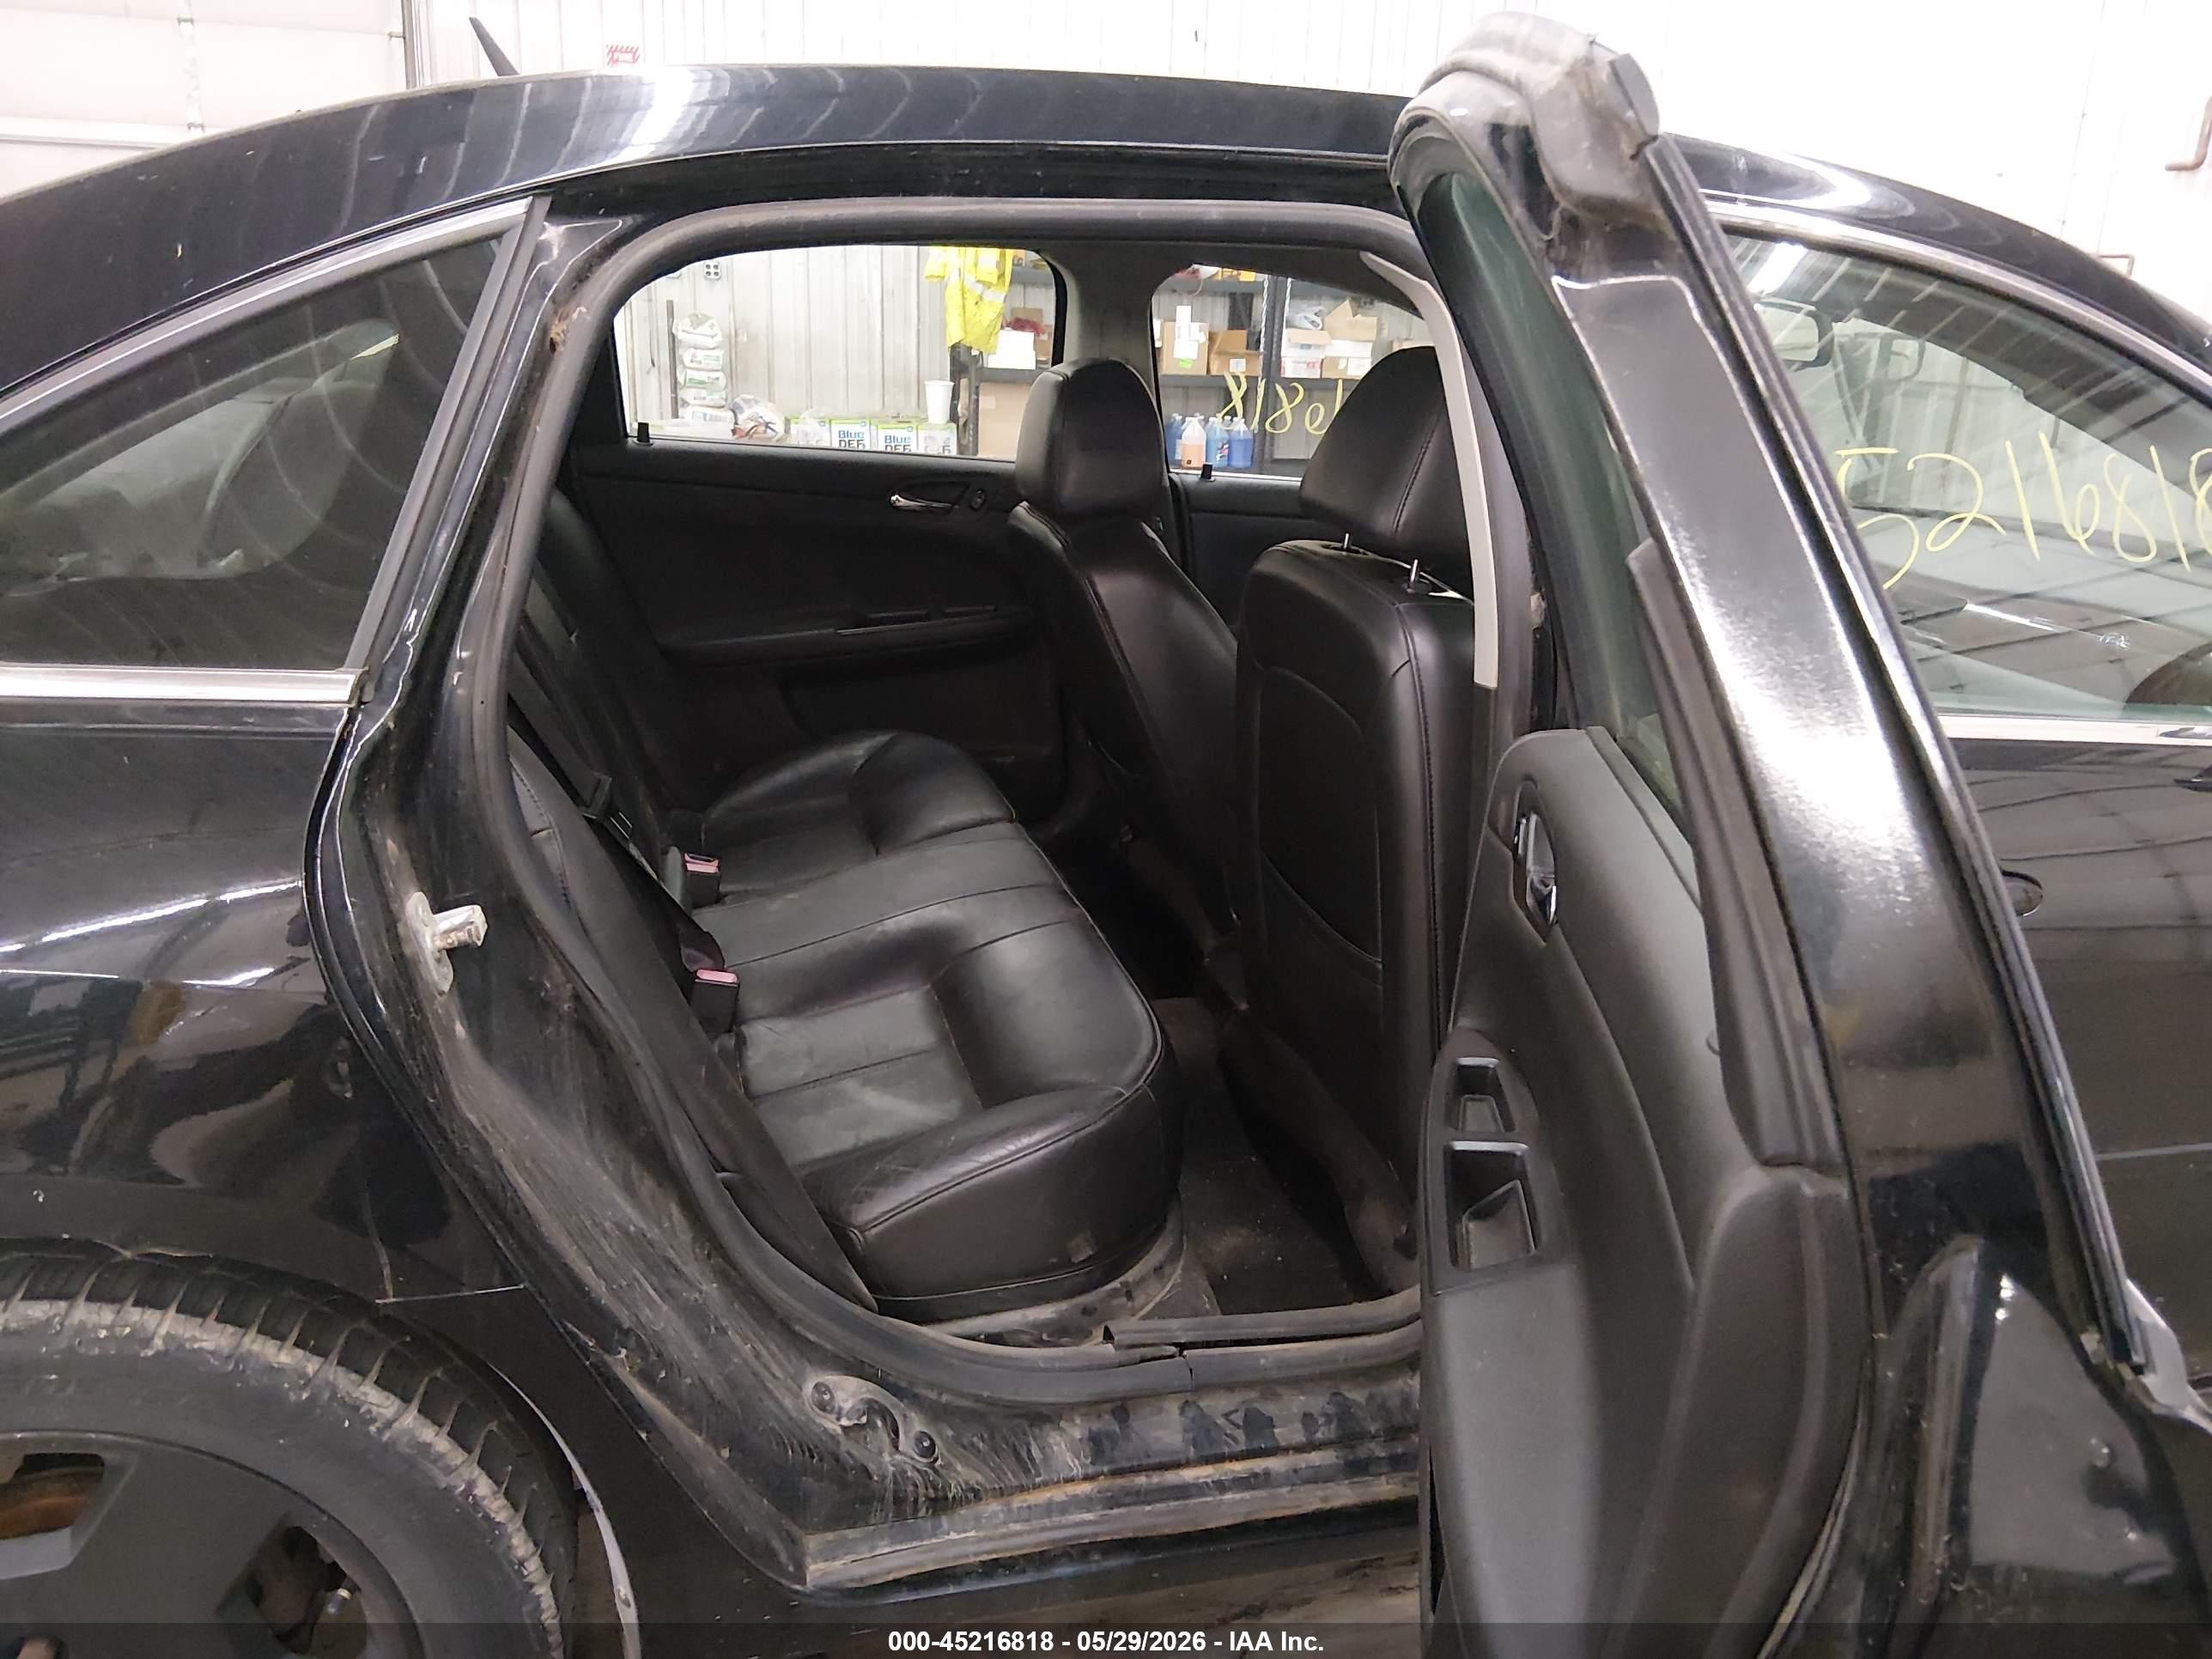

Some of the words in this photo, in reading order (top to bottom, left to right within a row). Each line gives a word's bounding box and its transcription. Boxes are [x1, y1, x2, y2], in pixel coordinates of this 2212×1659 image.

[838, 429, 865, 439] Blue
[884, 434, 911, 444] Blue
[838, 439, 865, 449] DEF
